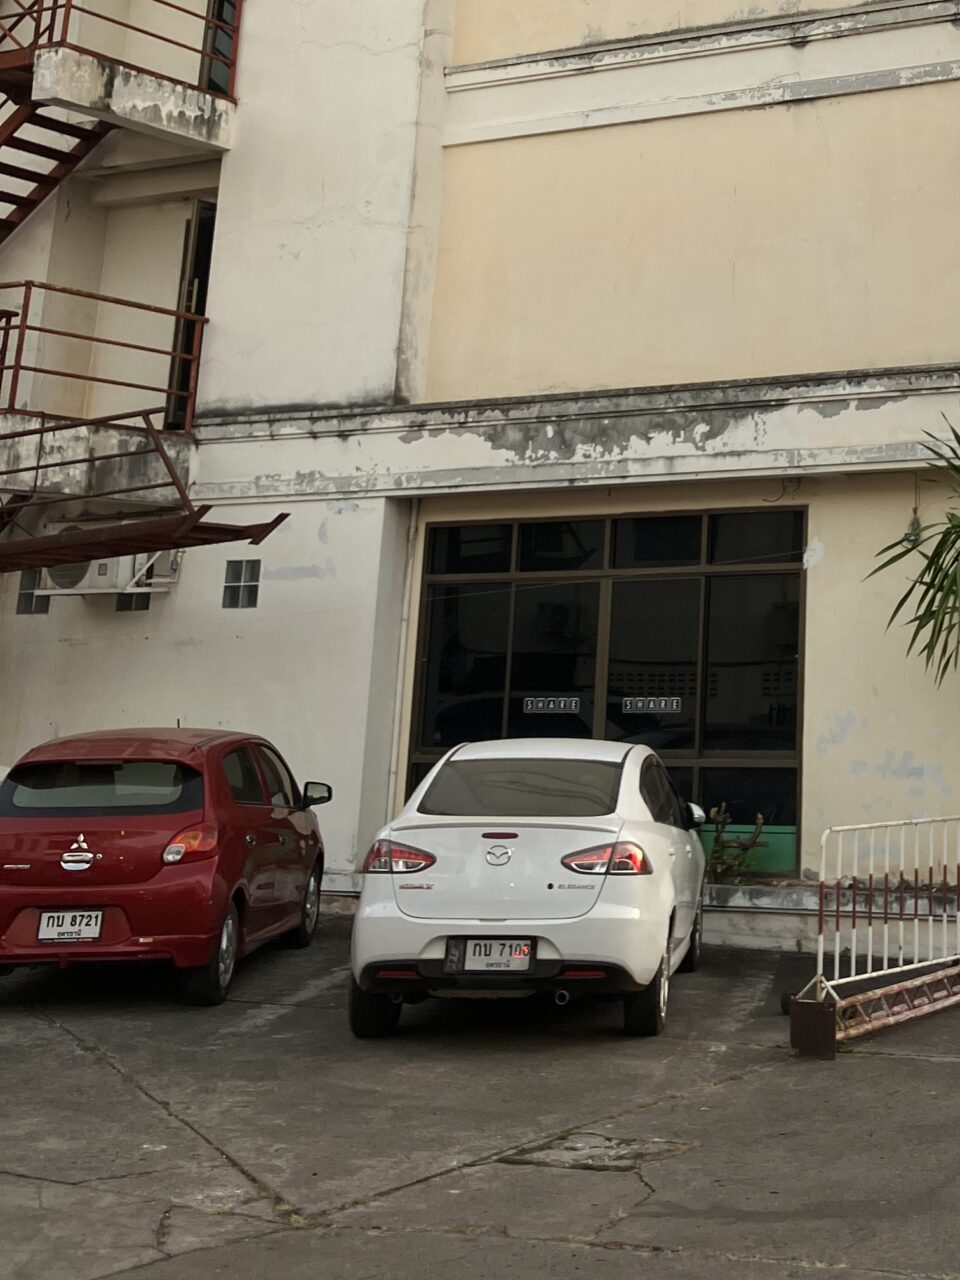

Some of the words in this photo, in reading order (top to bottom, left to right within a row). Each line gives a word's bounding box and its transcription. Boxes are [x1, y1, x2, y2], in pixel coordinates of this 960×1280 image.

[525, 699, 578, 711] SHARE
[624, 699, 679, 711] SHARE
[70, 914, 99, 927] 8721
